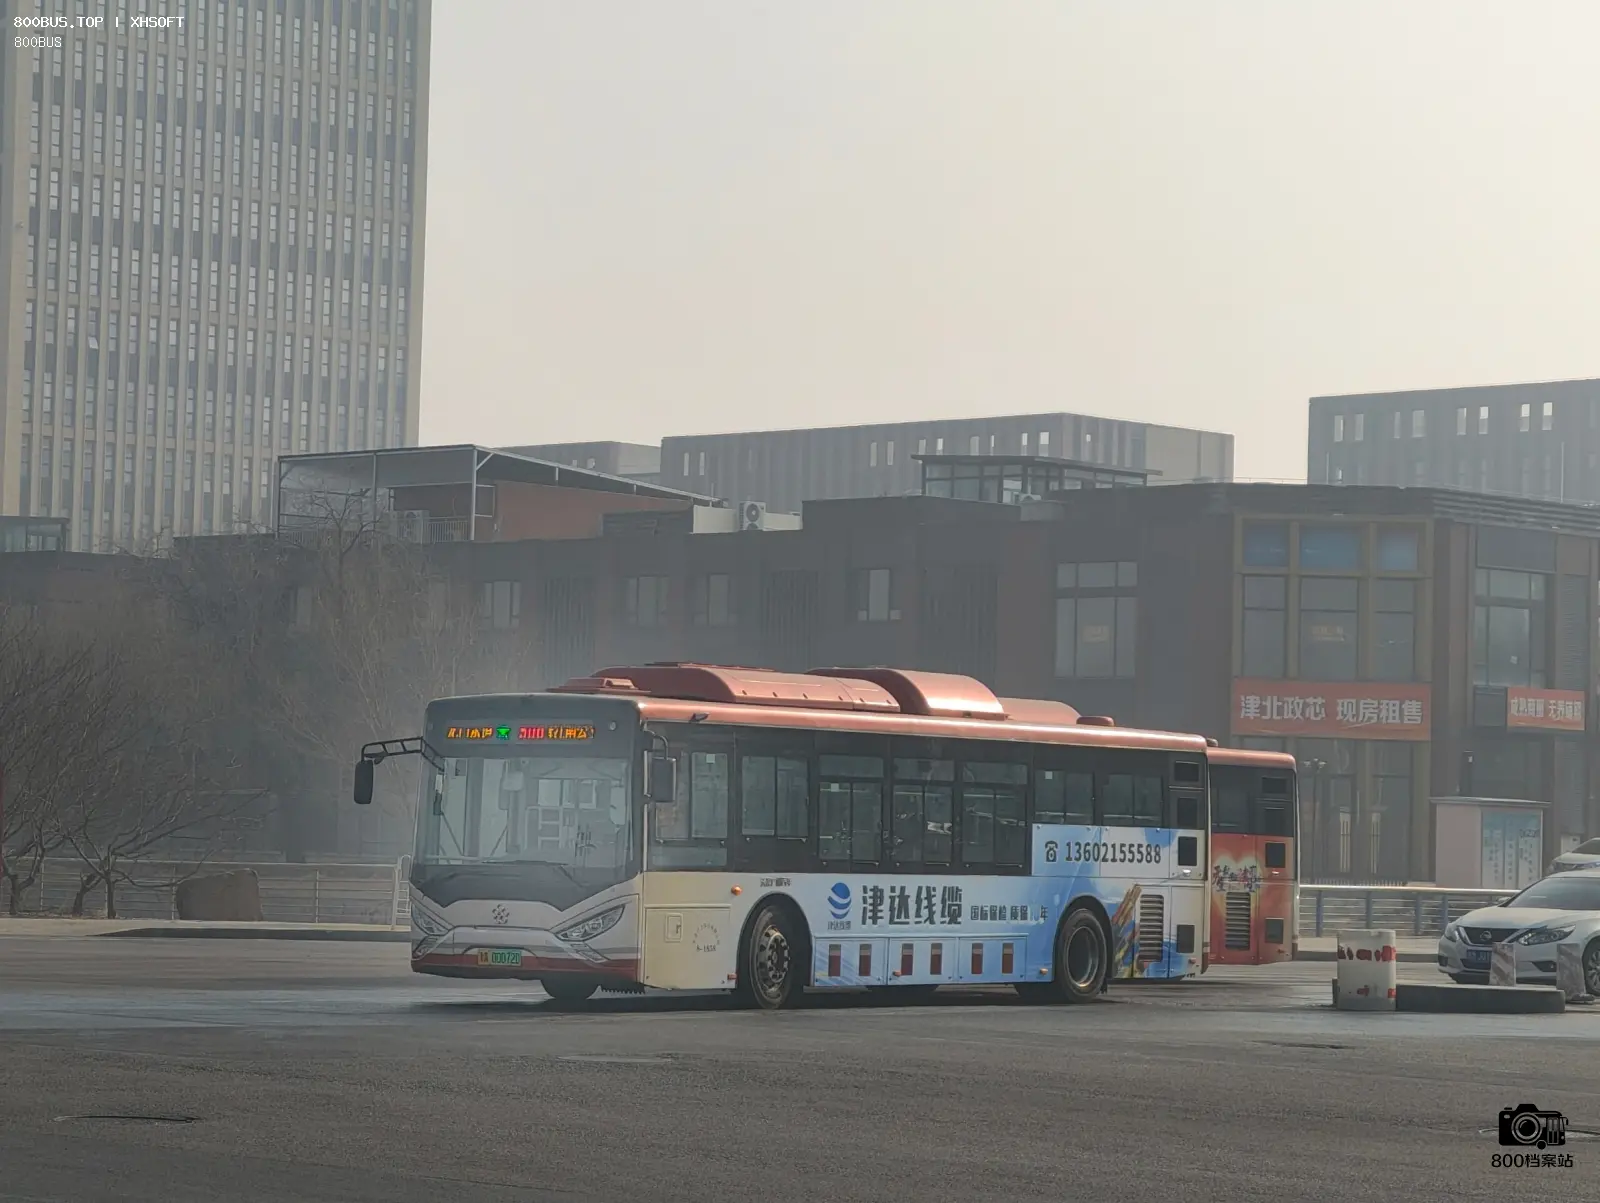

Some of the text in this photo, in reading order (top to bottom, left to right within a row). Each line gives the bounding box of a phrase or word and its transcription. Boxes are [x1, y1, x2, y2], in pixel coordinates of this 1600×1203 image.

[1239, 695, 1424, 725] 津北政芯 现房租售
[1065, 841, 1162, 864] 13602155588
[861, 885, 963, 925] 津达线缆
